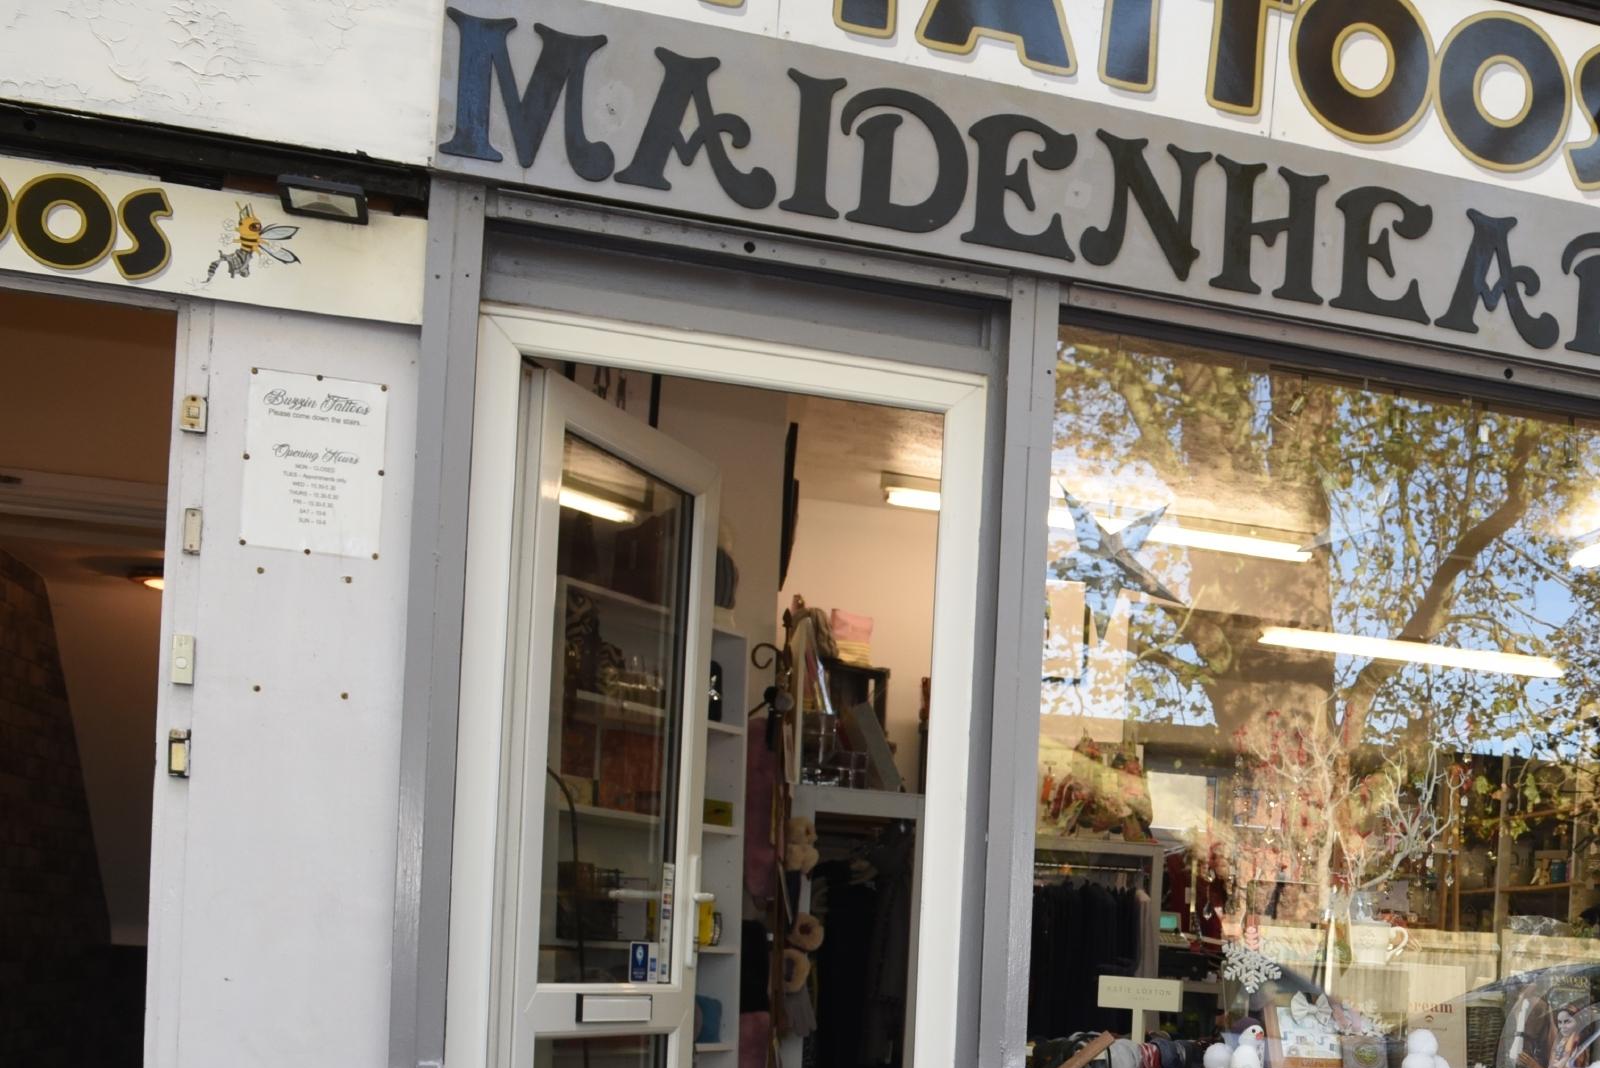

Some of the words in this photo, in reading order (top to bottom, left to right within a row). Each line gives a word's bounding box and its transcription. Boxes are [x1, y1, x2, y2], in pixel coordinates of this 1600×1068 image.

[263, 388, 318, 411] Buzzin
[319, 393, 371, 416] Tattoos
[272, 443, 319, 463] Opening
[321, 447, 360, 465] Hours
